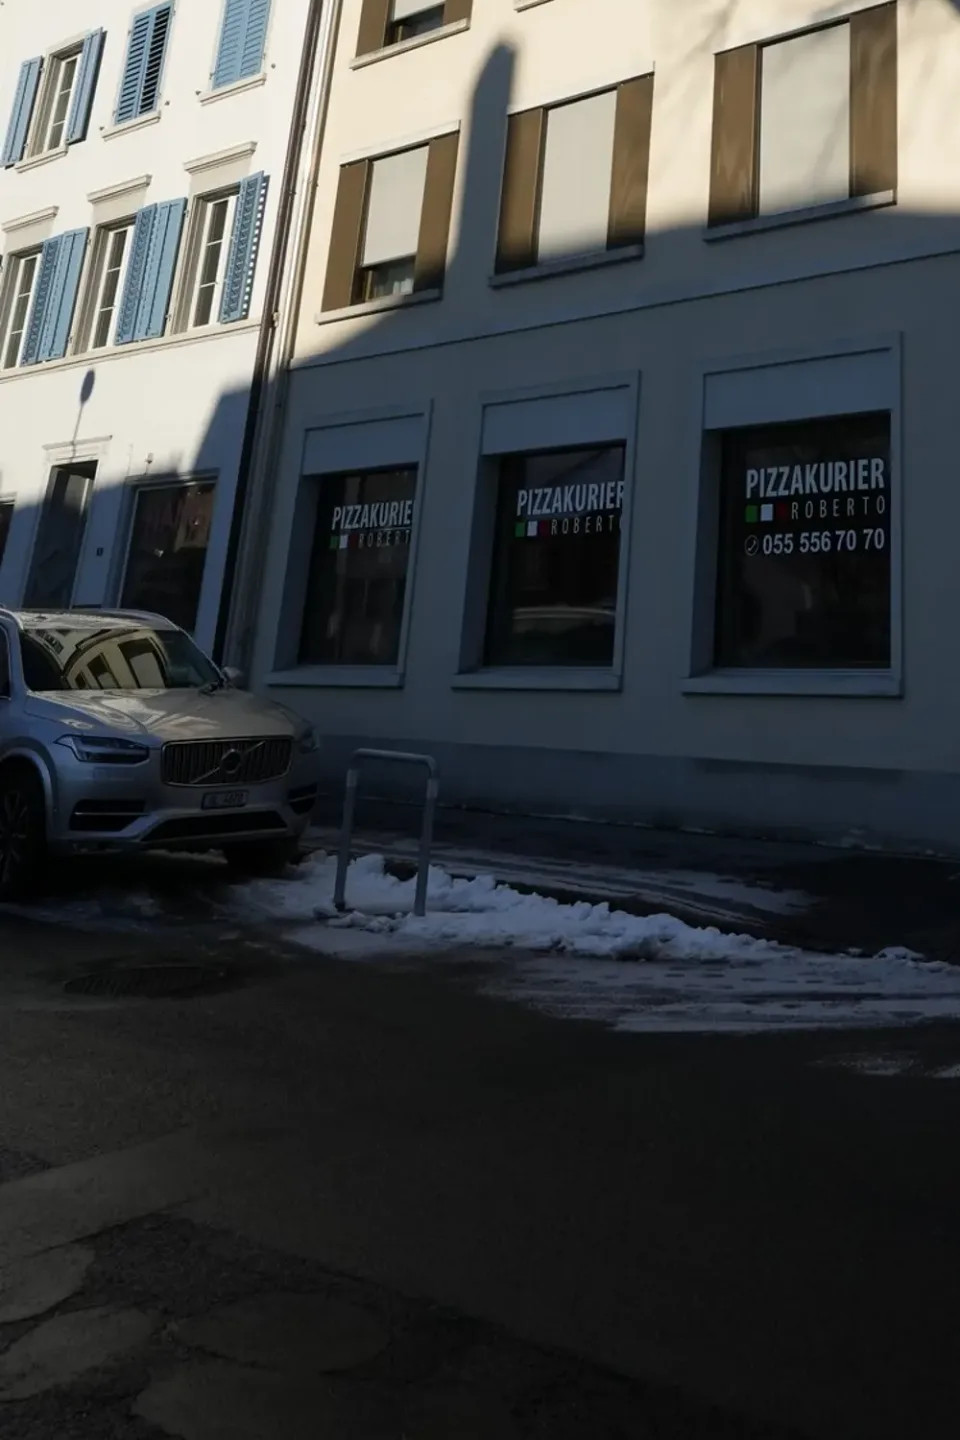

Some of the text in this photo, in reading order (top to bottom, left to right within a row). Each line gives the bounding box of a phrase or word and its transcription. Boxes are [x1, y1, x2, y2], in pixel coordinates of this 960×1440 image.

[746, 458, 885, 499] PIZZAKURIER
[791, 495, 886, 520] ROBERTO
[551, 515, 622, 536] ROBERT
[762, 527, 885, 555] 055 556 70 70
